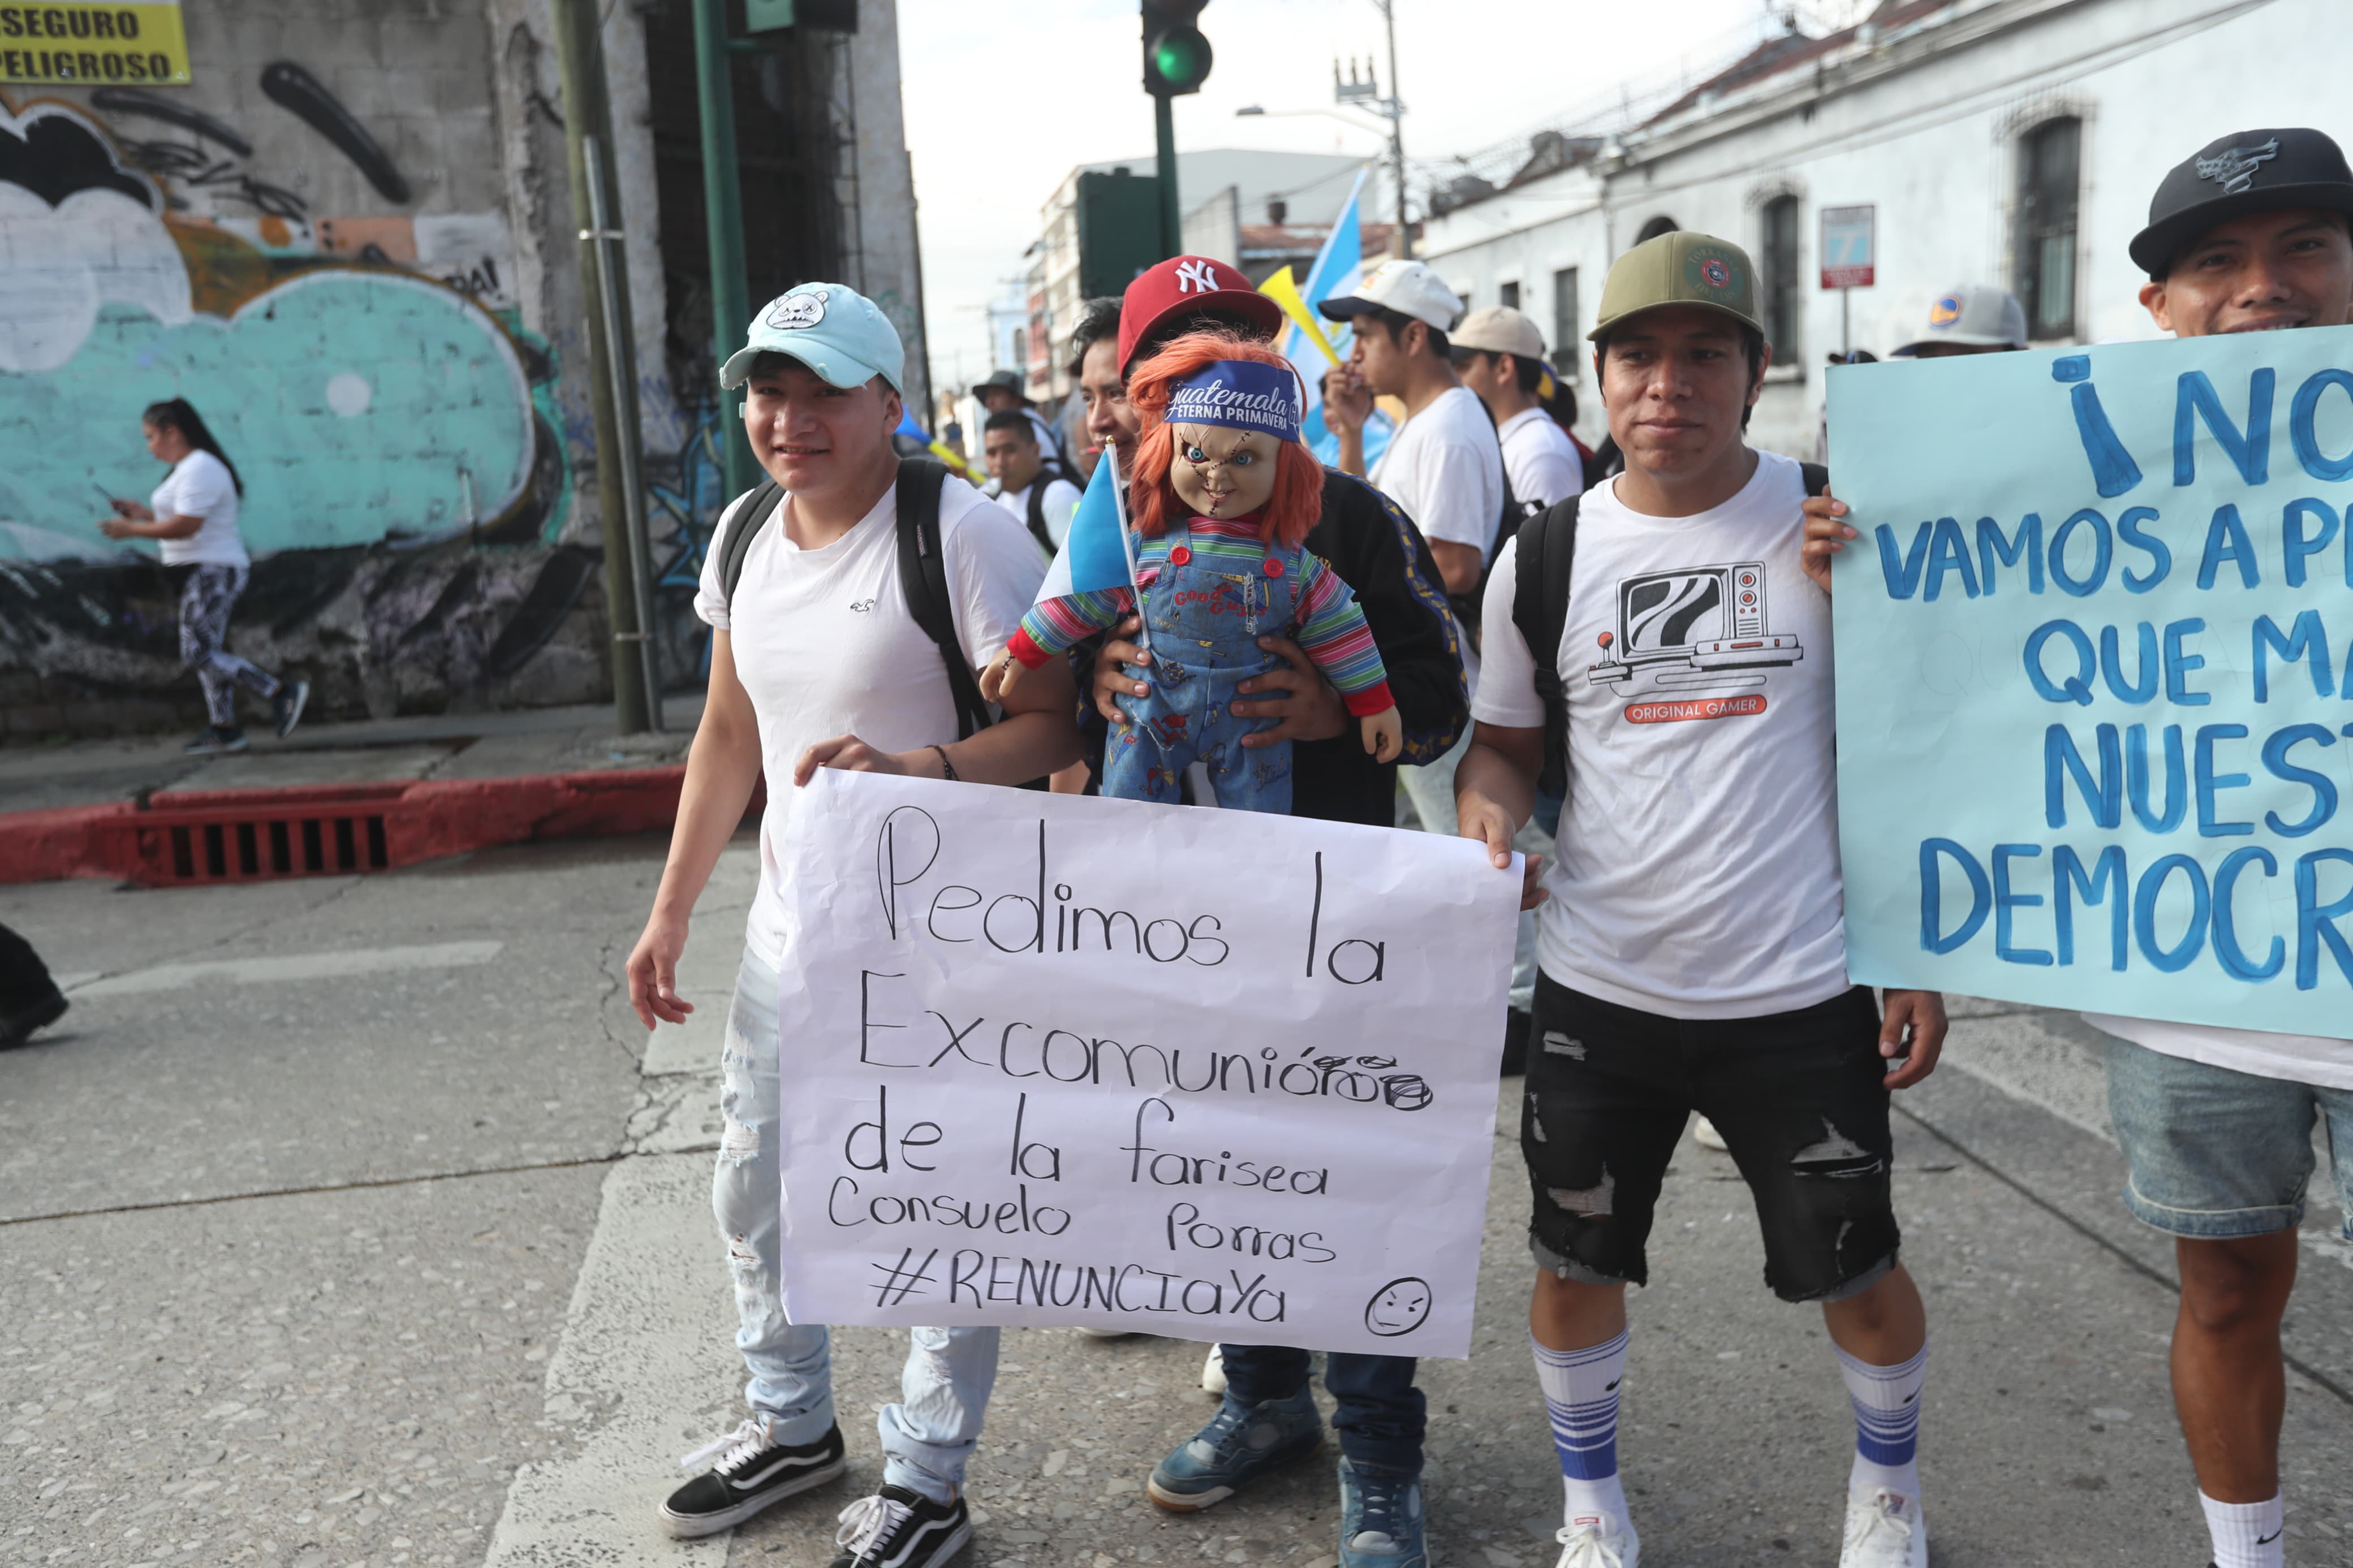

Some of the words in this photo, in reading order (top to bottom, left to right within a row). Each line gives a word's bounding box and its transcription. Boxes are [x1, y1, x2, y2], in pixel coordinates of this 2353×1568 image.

[0, 8, 140, 40] SEGURO
[0, 50, 172, 79] ELIGROSO
[1175, 260, 1220, 293] NY
[1165, 379, 1288, 421] Guatemala
[1178, 404, 1222, 419] ETERNA
[1226, 407, 1287, 430] PRIMAVERA
[1875, 507, 2171, 602] VAMOS
[2197, 504, 2260, 590] A
[2282, 498, 2353, 589] P
[2023, 617, 2210, 706] QUE
[2252, 609, 2353, 703] M
[1632, 704, 1701, 720] ORIGINAL
[1706, 699, 1757, 715] GAMER
[2045, 723, 2353, 837] NUES
[877, 806, 1229, 966] Pedimos
[1307, 851, 1385, 984] la
[1920, 837, 2353, 991] DEMOCR
[845, 1085, 942, 1173] de
[1011, 1092, 1059, 1182] la
[1120, 1098, 1328, 1195] farisea
[829, 1177, 1071, 1236] Consuelo
[1167, 1203, 1336, 1263] Porras
